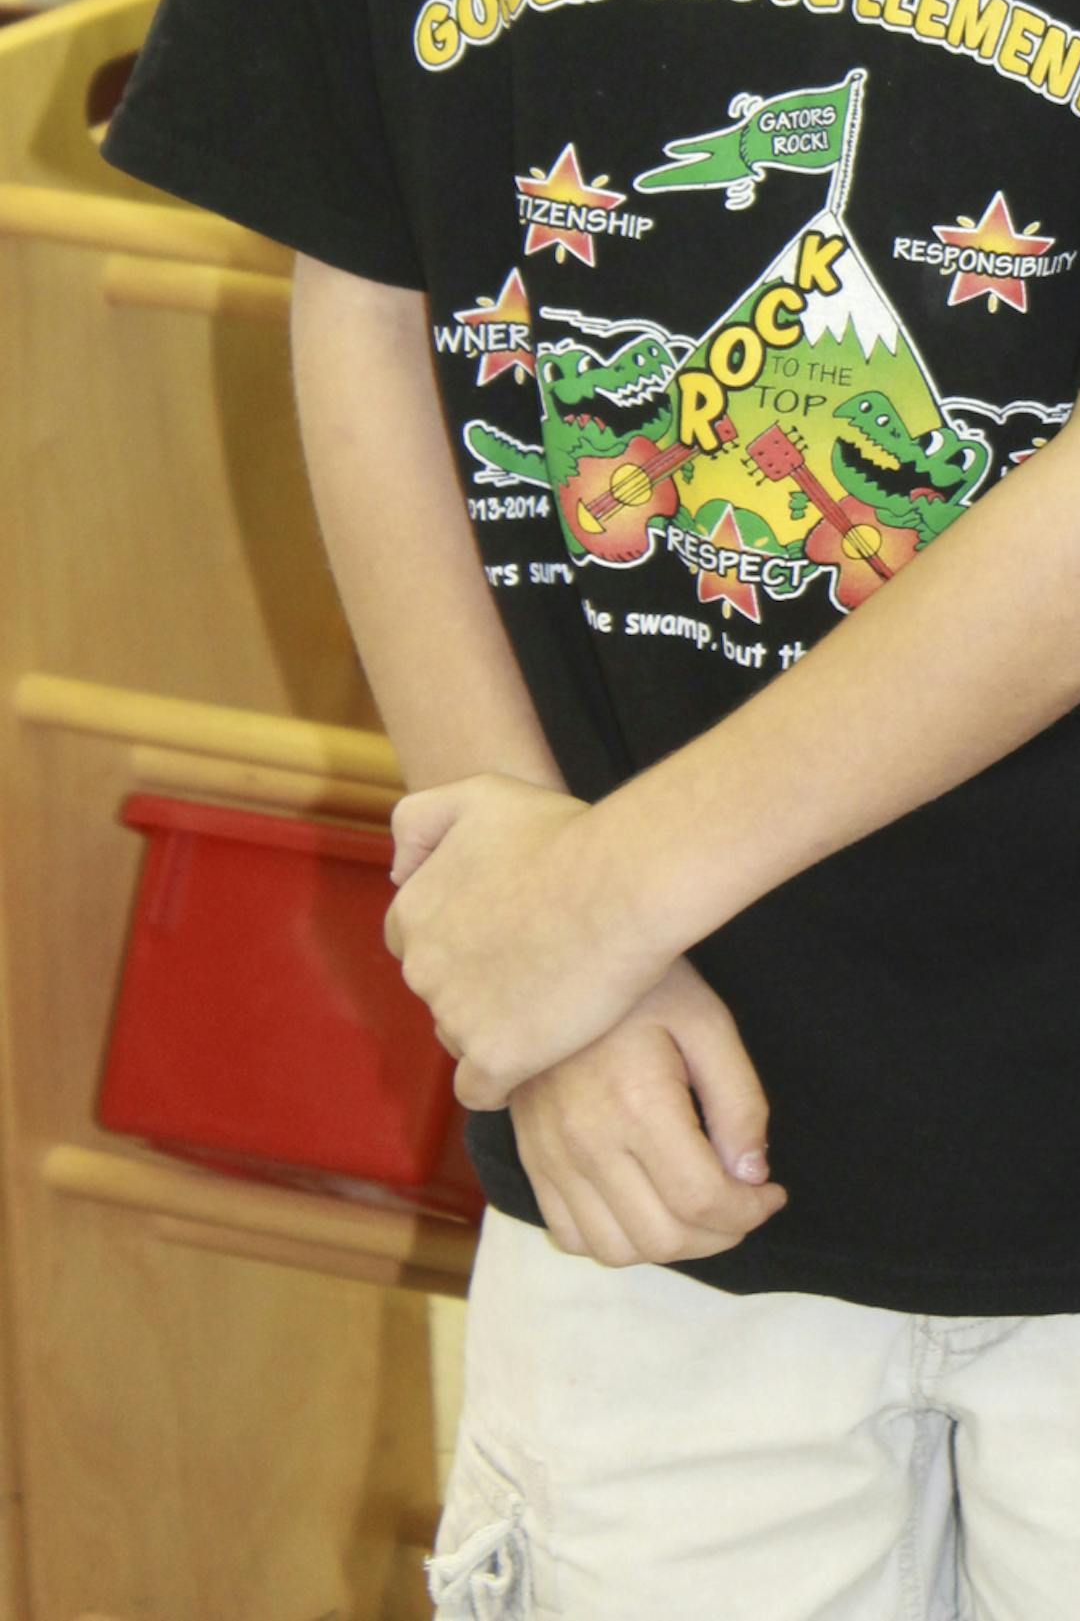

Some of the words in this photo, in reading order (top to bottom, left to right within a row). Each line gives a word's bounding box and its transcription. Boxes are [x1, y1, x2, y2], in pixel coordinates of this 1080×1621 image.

[759, 106, 837, 132] GATORS
[773, 132, 828, 156] ROCK!
[515, 194, 653, 240] TIZENSHIP
[893, 237, 1077, 278] RESPONSIBILITY
[433, 323, 533, 356] WNER
[678, 231, 846, 454] ROCK
[771, 356, 800, 379] TO
[808, 362, 853, 388] THE
[754, 385, 828, 418] TOP
[468, 495, 550, 521] 013-2014
[667, 525, 809, 587] RESPECT
[528, 562, 574, 585] surv
[721, 631, 767, 669] but
[778, 641, 809, 671] th
